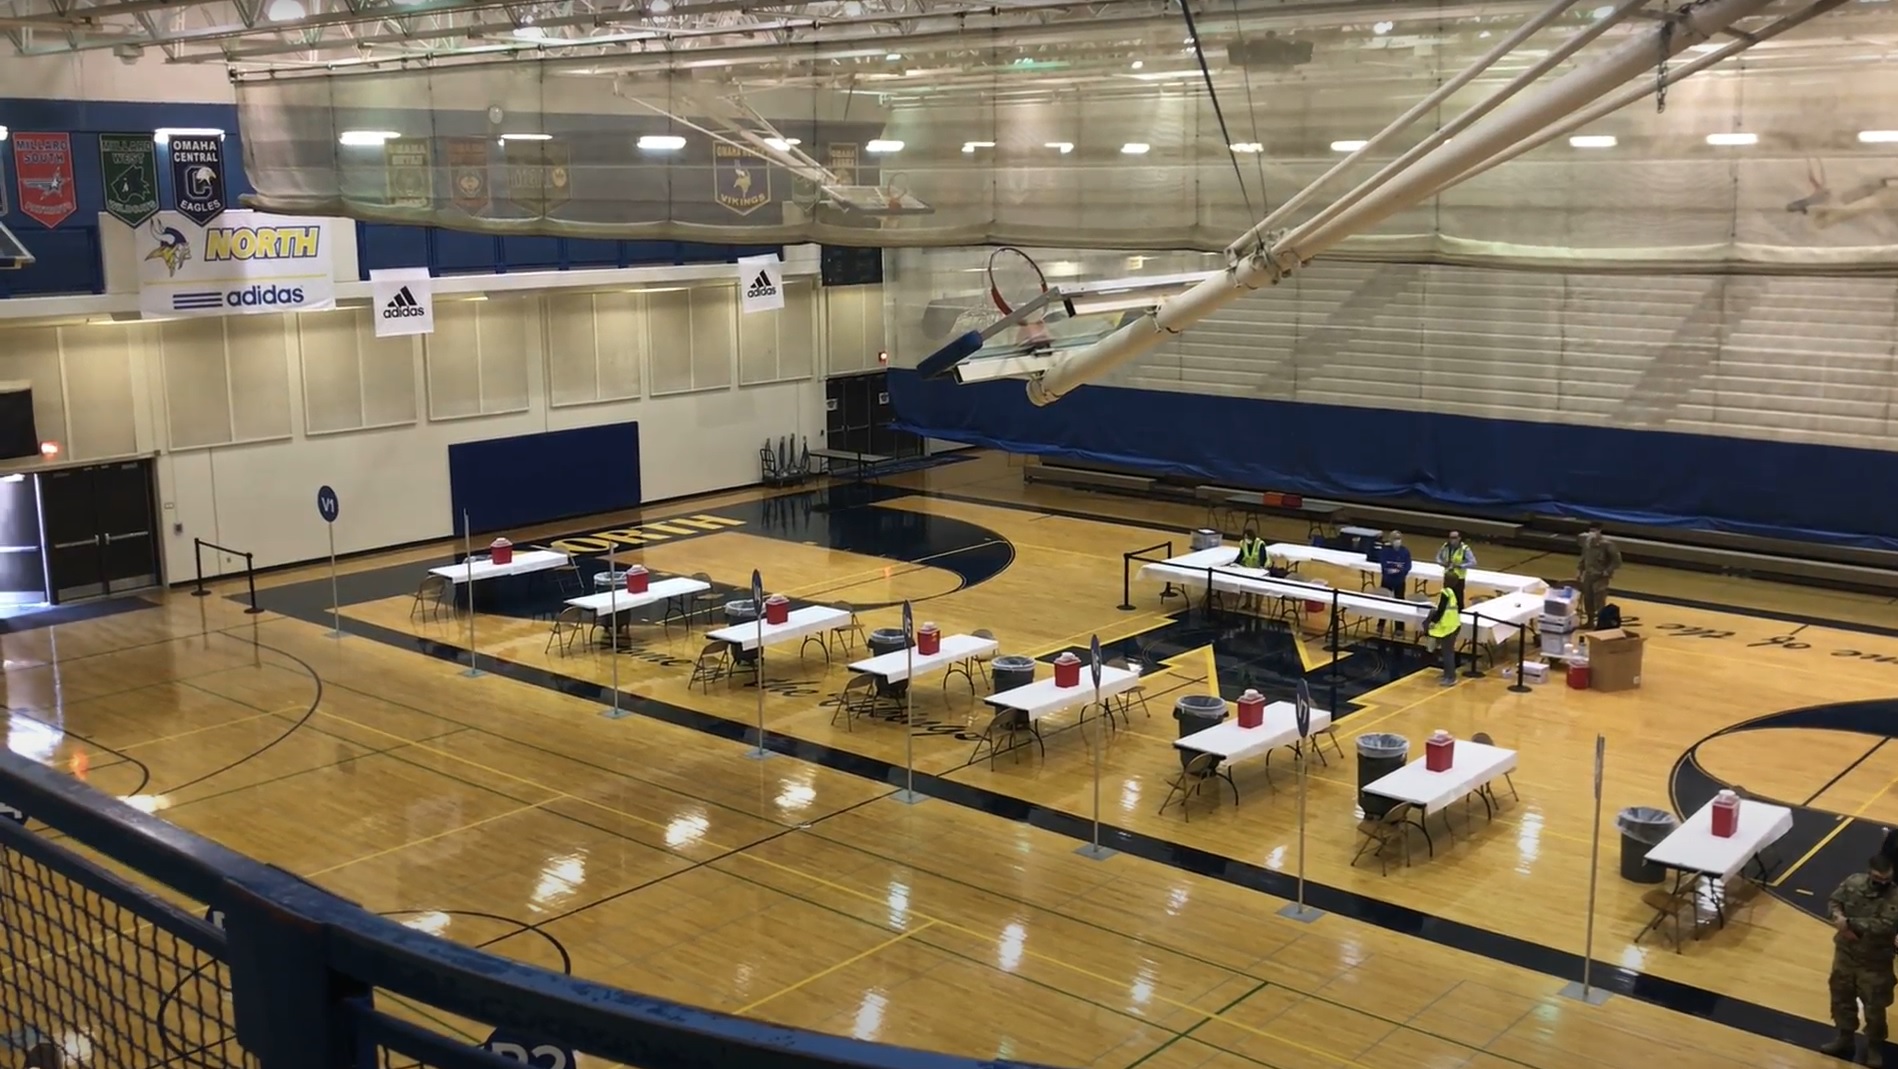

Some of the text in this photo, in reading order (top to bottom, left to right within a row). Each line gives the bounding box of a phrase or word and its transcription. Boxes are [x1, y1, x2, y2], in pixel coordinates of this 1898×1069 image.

[173, 141, 217, 151] OMAHA
[24, 152, 65, 164] SOUTH
[173, 152, 218, 162] CENTRAL
[180, 199, 221, 212] EAGLES
[720, 193, 766, 206] VIKINGS
[204, 225, 320, 261] NORTH
[226, 284, 304, 307] adidas
[747, 286, 777, 298] adidas
[383, 305, 425, 319] adidas
[321, 497, 335, 513] V1
[511, 514, 748, 556] ORTH
